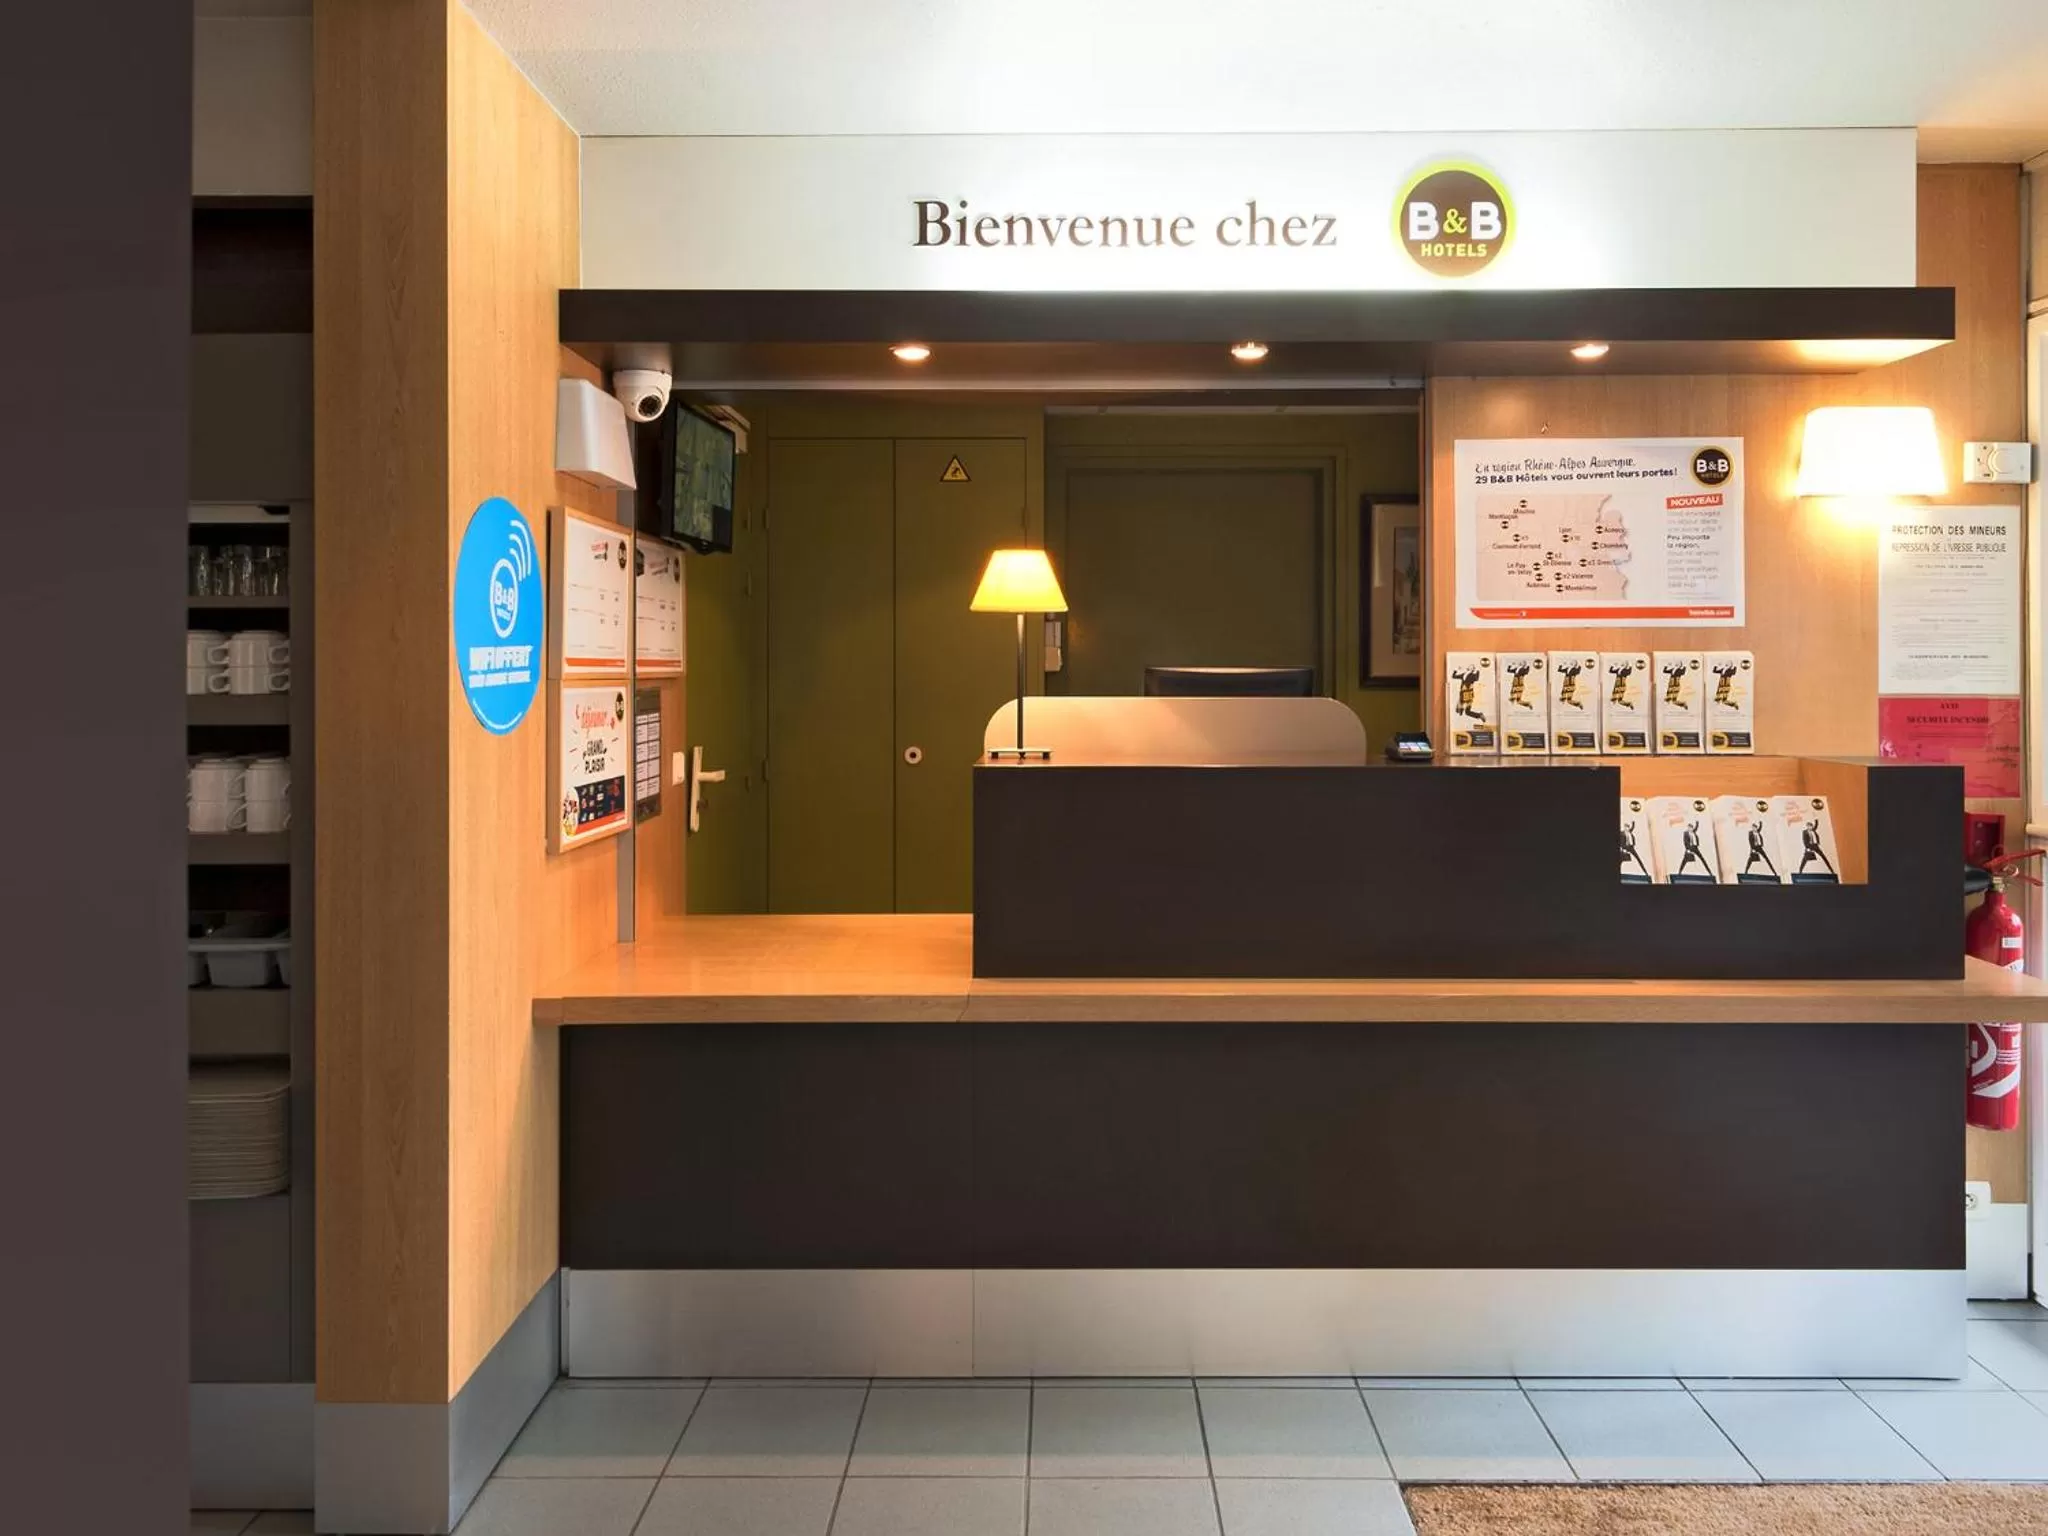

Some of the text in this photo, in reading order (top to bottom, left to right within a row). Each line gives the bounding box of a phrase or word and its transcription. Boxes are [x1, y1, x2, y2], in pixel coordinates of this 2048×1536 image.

[913, 200, 1338, 247] Bienvenue chez
[1409, 201, 1502, 240] B&B
[1421, 243, 1488, 258] HOTELS
[1696, 458, 1730, 473] B&B
[1475, 475, 1488, 485] 29
[1490, 474, 1514, 484] B&B
[1516, 472, 1549, 483] Hôtels
[1551, 473, 1574, 481] vous
[1576, 470, 1615, 480] ouvrent
[1616, 469, 1641, 479] leurs
[1671, 496, 1720, 507] NOUVEAU
[1892, 525, 2007, 536] PROTECTION DES MINEURS
[1932, 543, 1941, 552] DE
[1976, 543, 2007, 553] PUBLIQUE
